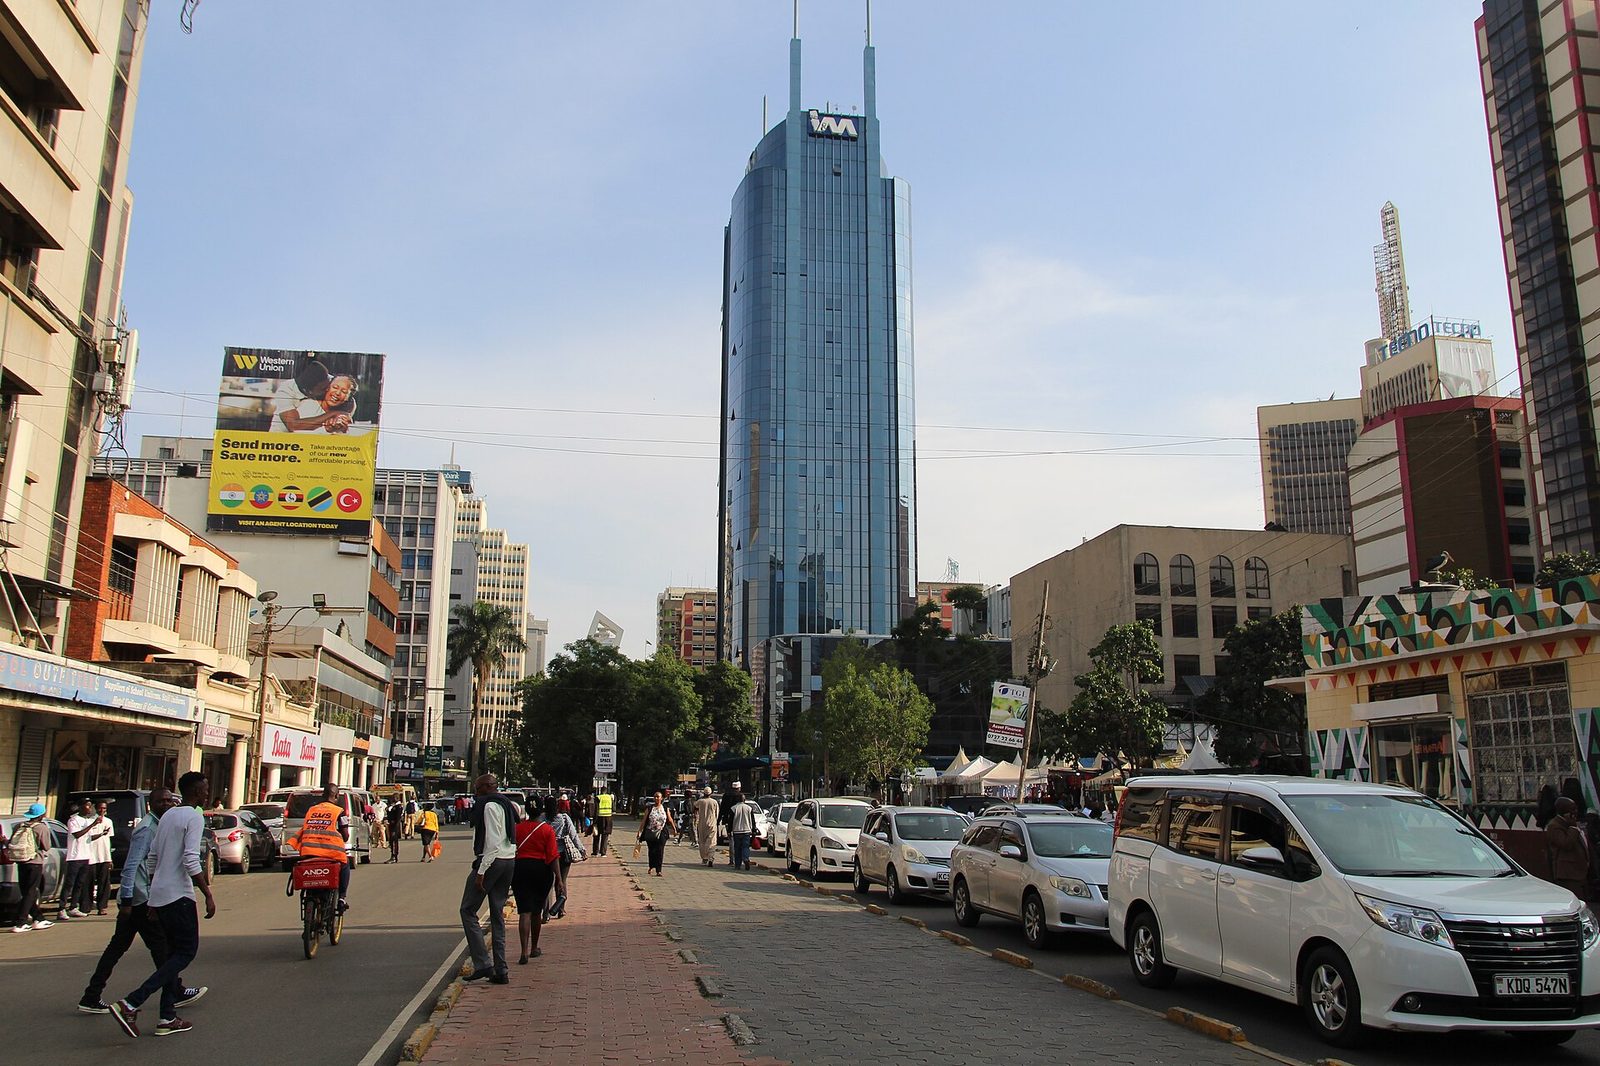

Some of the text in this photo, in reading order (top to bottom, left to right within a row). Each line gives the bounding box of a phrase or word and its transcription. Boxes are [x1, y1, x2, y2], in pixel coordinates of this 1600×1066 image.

[259, 363, 284, 371] Union
[260, 356, 295, 366] Western
[221, 438, 304, 451] Send more.
[220, 450, 301, 463] Save more.
[272, 730, 316, 761] Bata Bata
[303, 868, 330, 876] ANDO
[1507, 977, 1568, 994] KDQ 547N
